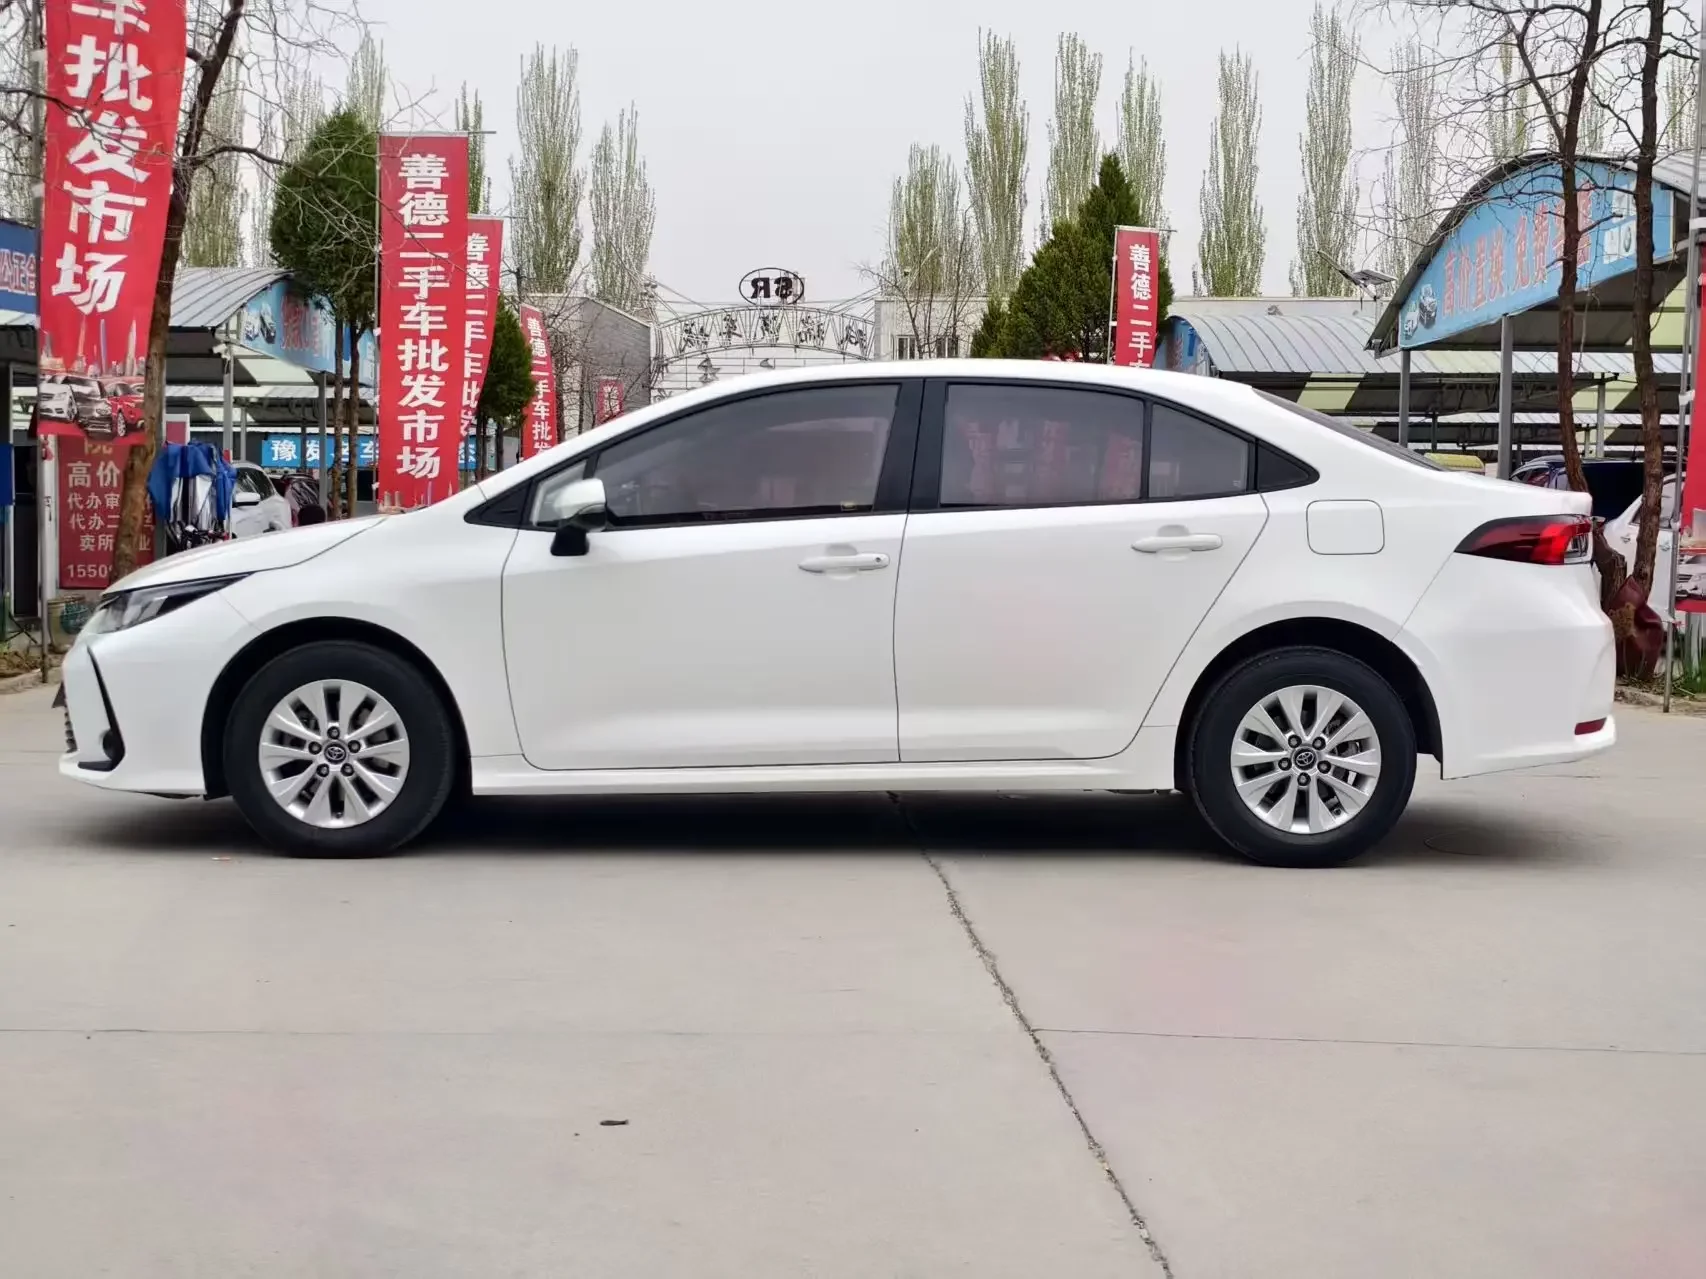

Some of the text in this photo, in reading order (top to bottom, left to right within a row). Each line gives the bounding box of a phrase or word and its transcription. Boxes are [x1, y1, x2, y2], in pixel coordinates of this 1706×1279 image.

[398, 154, 450, 479] 善德二手车批发市场
[67, 461, 120, 488] 高价
[67, 564, 112, 578] 1550
